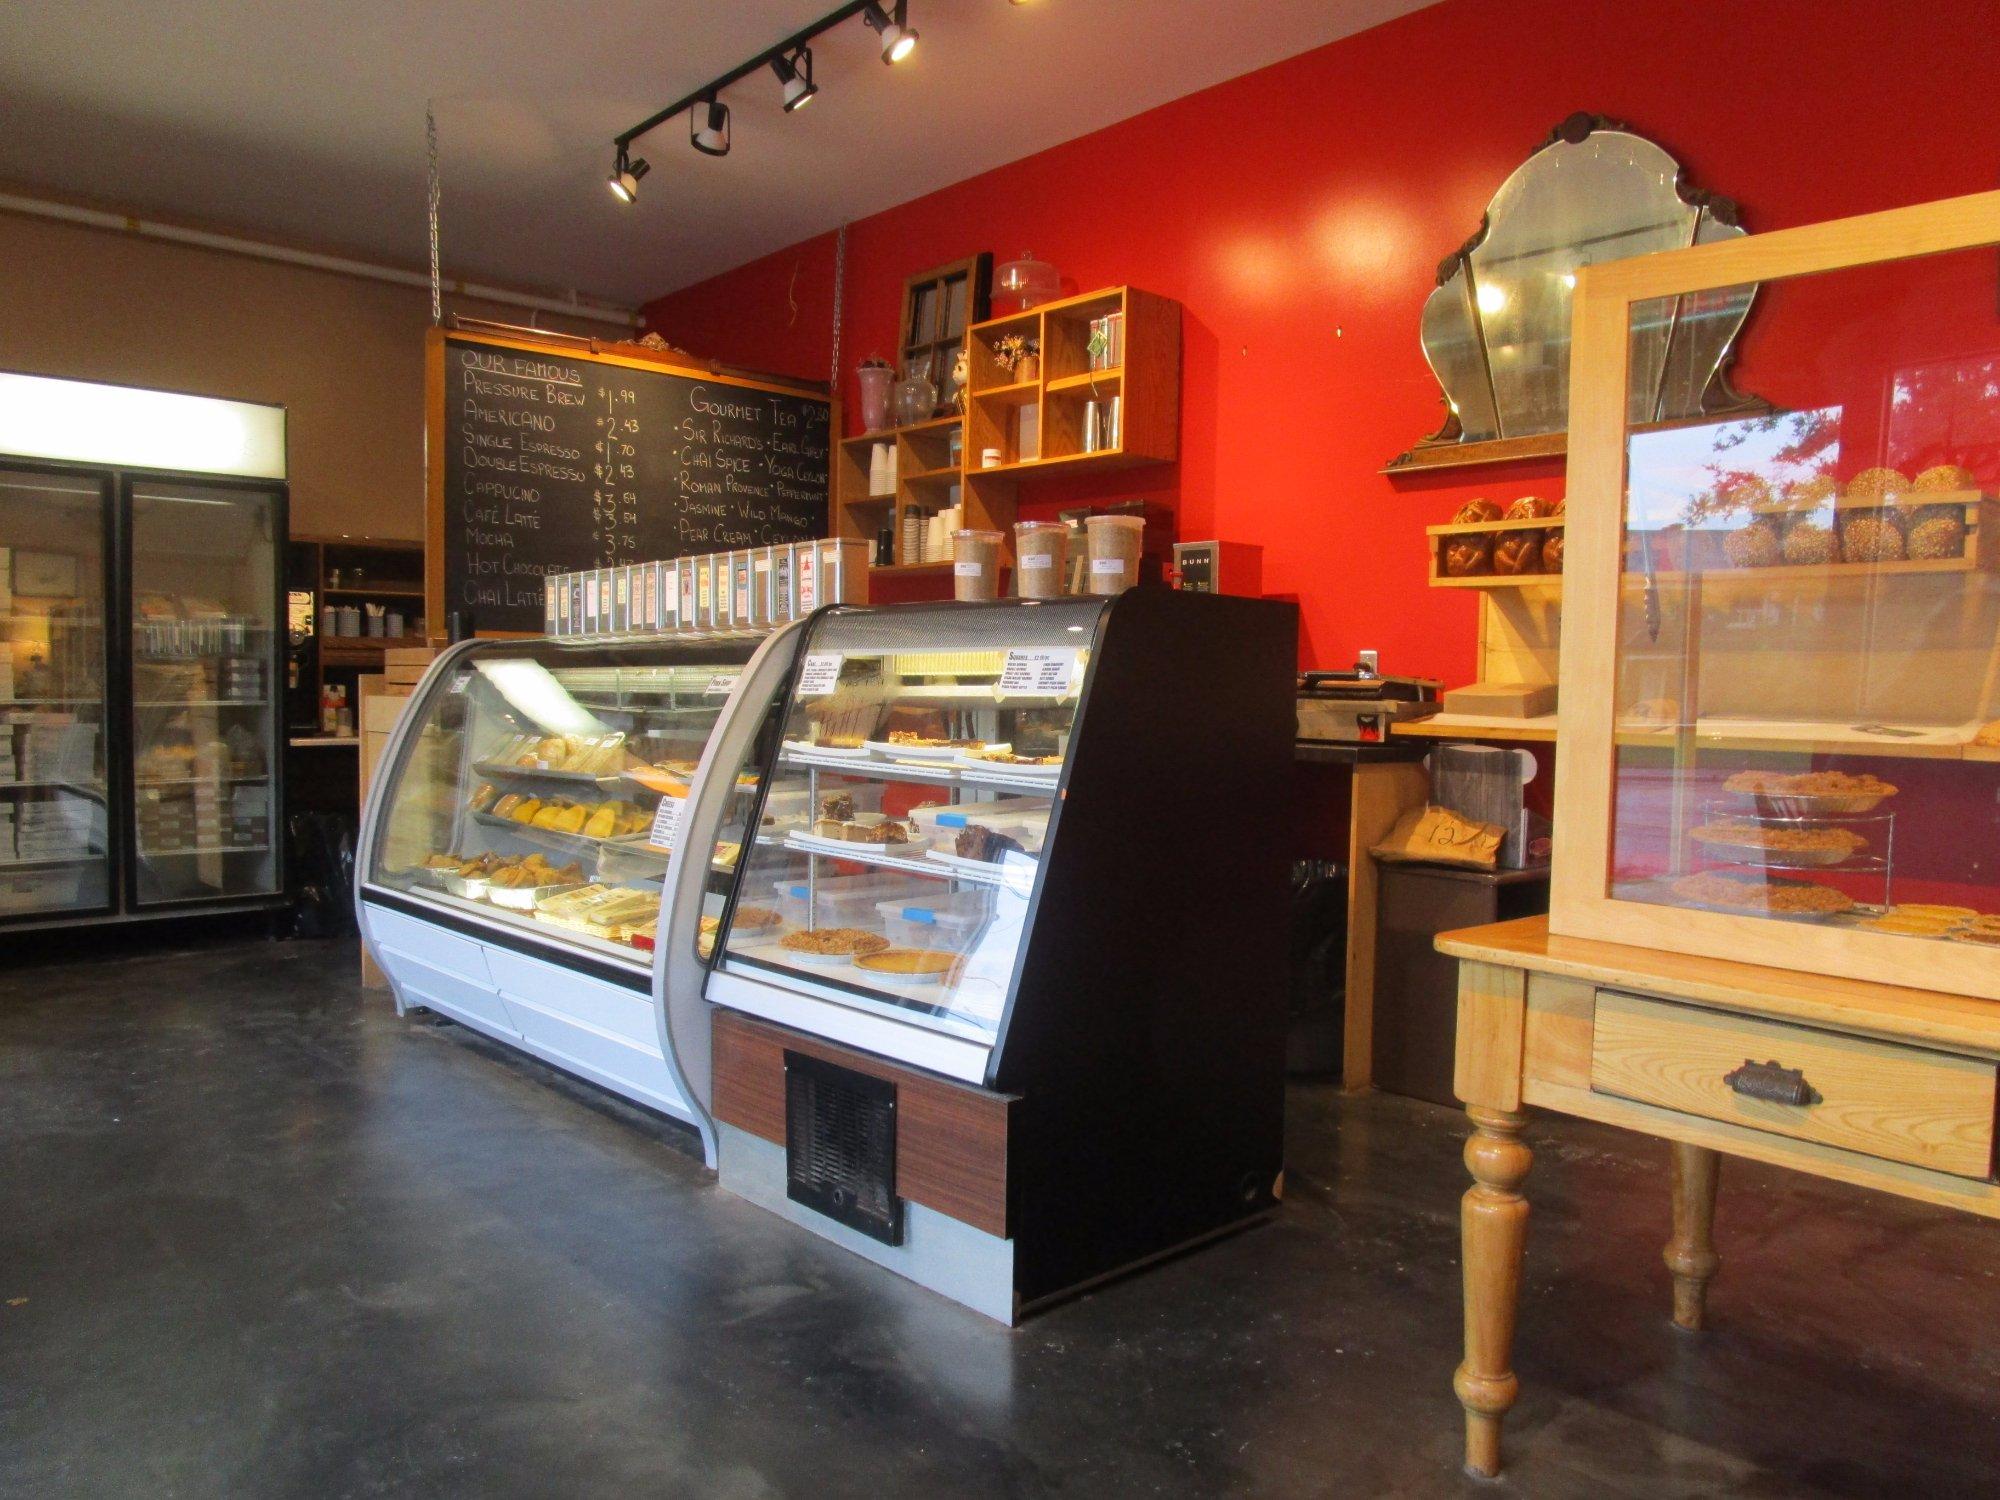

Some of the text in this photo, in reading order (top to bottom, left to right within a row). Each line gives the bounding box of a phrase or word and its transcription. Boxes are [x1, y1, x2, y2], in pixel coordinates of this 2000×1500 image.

[462, 350, 581, 383] OUR FAMOUS
[464, 371, 635, 414] PRESSURE BREW $1.99
[691, 386, 761, 421] GOURMET
[769, 399, 796, 428] TEA
[464, 399, 641, 441] AMERICANO $2.43
[462, 423, 635, 463] SINGLE ESPRESSO $1.70
[683, 418, 707, 445] SIR
[773, 433, 799, 455] EARL
[464, 446, 517, 472] DOUBLE
[520, 456, 585, 483] ESPRESSO
[681, 446, 826, 484] CHAI SPICE YOGA CEYLON
[464, 472, 540, 503] CAPPUCINO
[681, 471, 823, 501] ROMAN PROVENCE PEPPERMINT
[680, 496, 808, 528] JASMINE WILD MANGO
[465, 528, 514, 548] MOCHA
[680, 518, 709, 542] PEAR
[714, 523, 753, 546] CREAM
[468, 553, 500, 576] HOT
[1182, 558, 1209, 566] BUNN
[464, 580, 501, 606] CHAI
